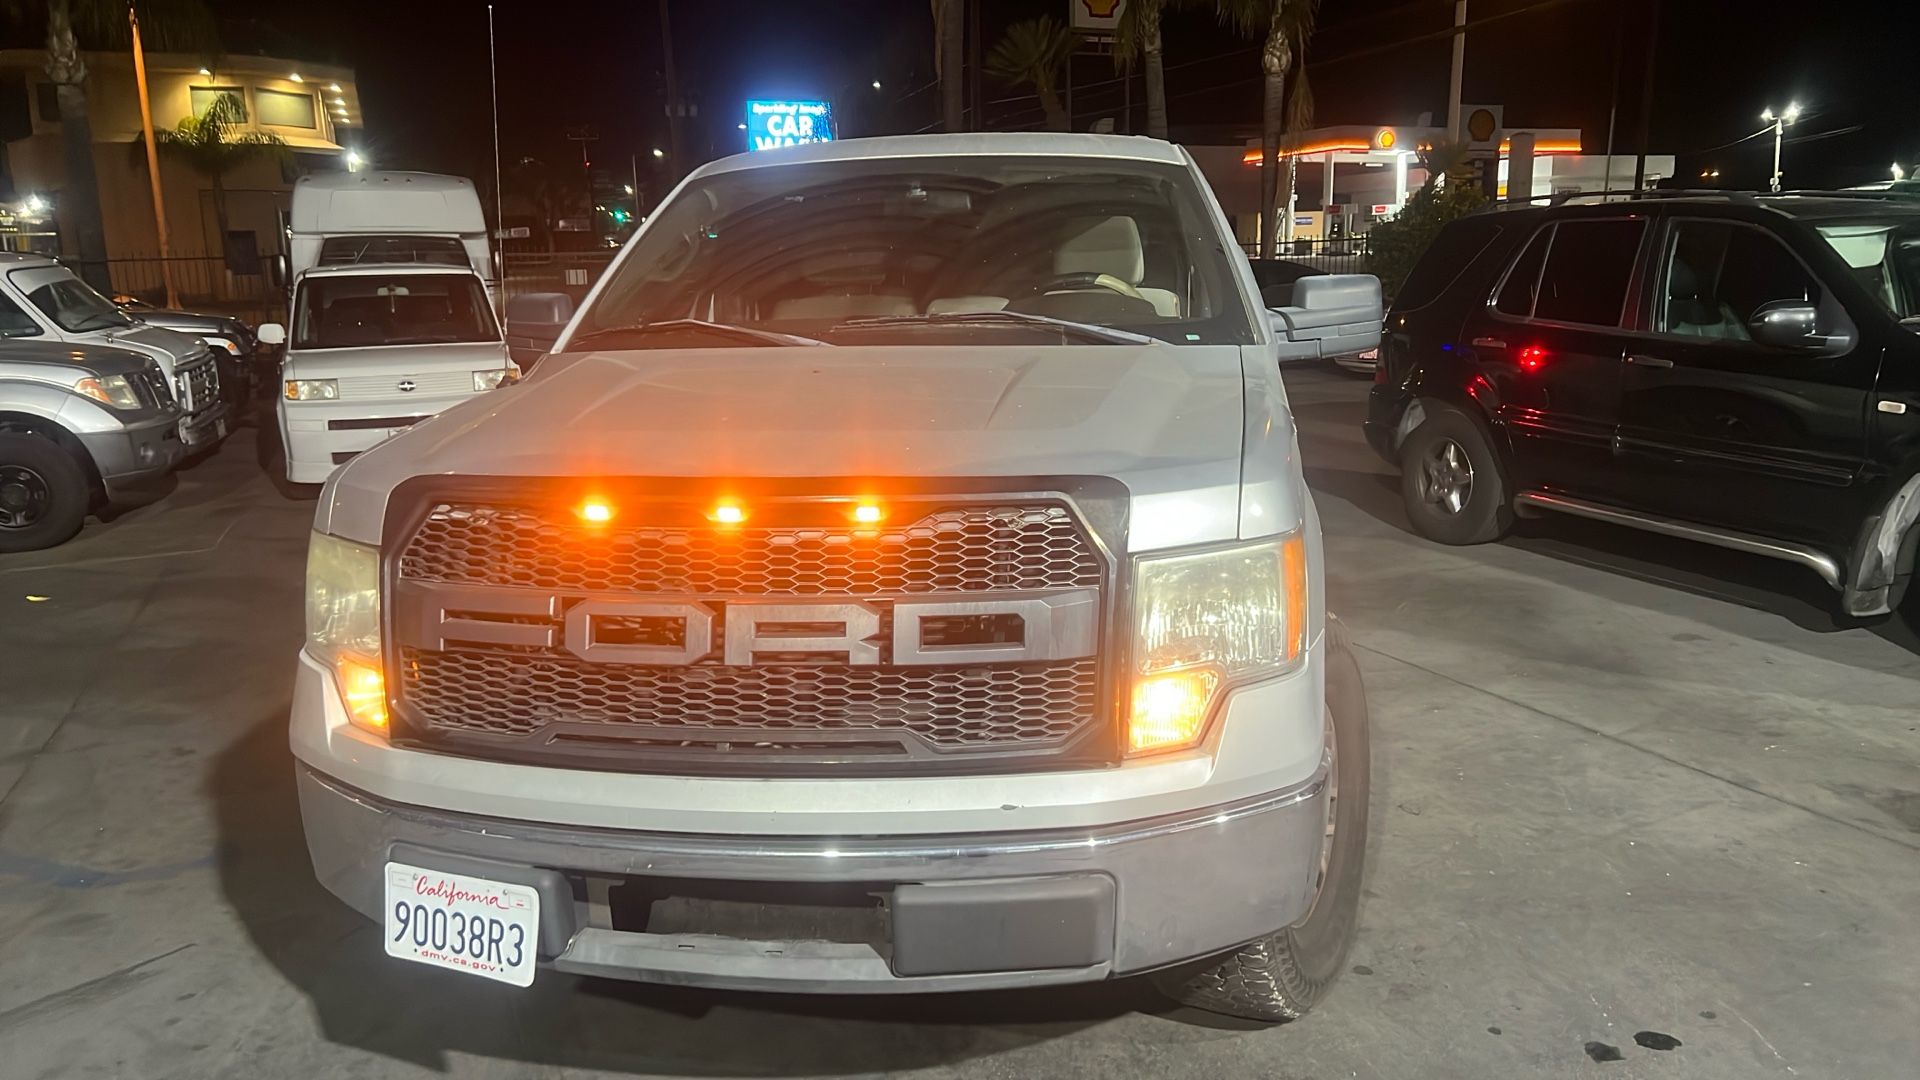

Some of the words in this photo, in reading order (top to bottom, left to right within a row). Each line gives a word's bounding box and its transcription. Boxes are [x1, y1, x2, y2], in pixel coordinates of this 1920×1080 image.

[767, 115, 813, 136] CAR
[405, 586, 1097, 665] FORD
[416, 875, 509, 910] California
[394, 900, 525, 967] 90038R3
[421, 949, 496, 972] dmv.ca.gov
